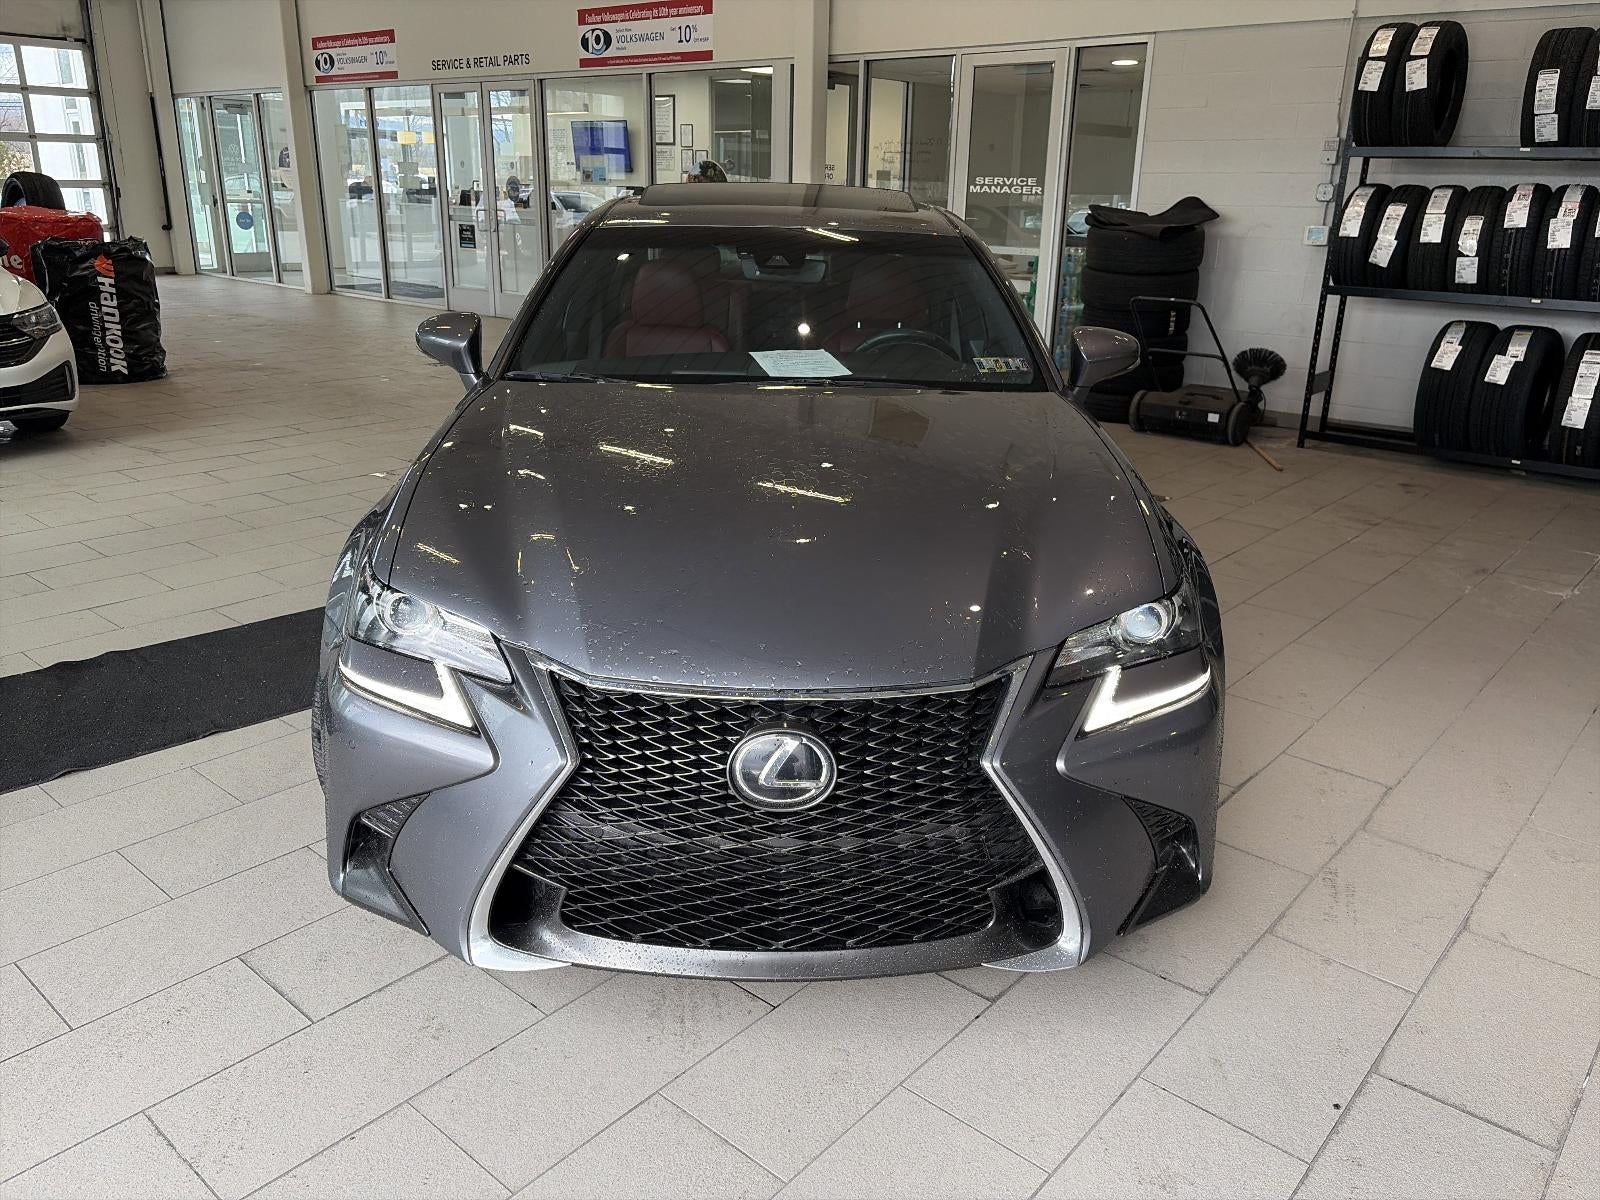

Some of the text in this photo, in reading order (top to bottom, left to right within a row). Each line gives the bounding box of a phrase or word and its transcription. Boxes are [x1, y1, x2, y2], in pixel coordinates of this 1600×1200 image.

[602, 12, 625, 23] Volkswagen
[630, 8, 652, 20] Celebrating
[659, 5, 668, 17] 10th
[669, 7, 679, 18] year
[615, 32, 665, 44] VOLKSWAGEN
[337, 55, 368, 65] VOLKSWAGEN
[431, 53, 530, 71] SERVICE & RETAIL PARTS
[975, 176, 1038, 186] SERVICE
[969, 185, 1043, 195] MANAGER
